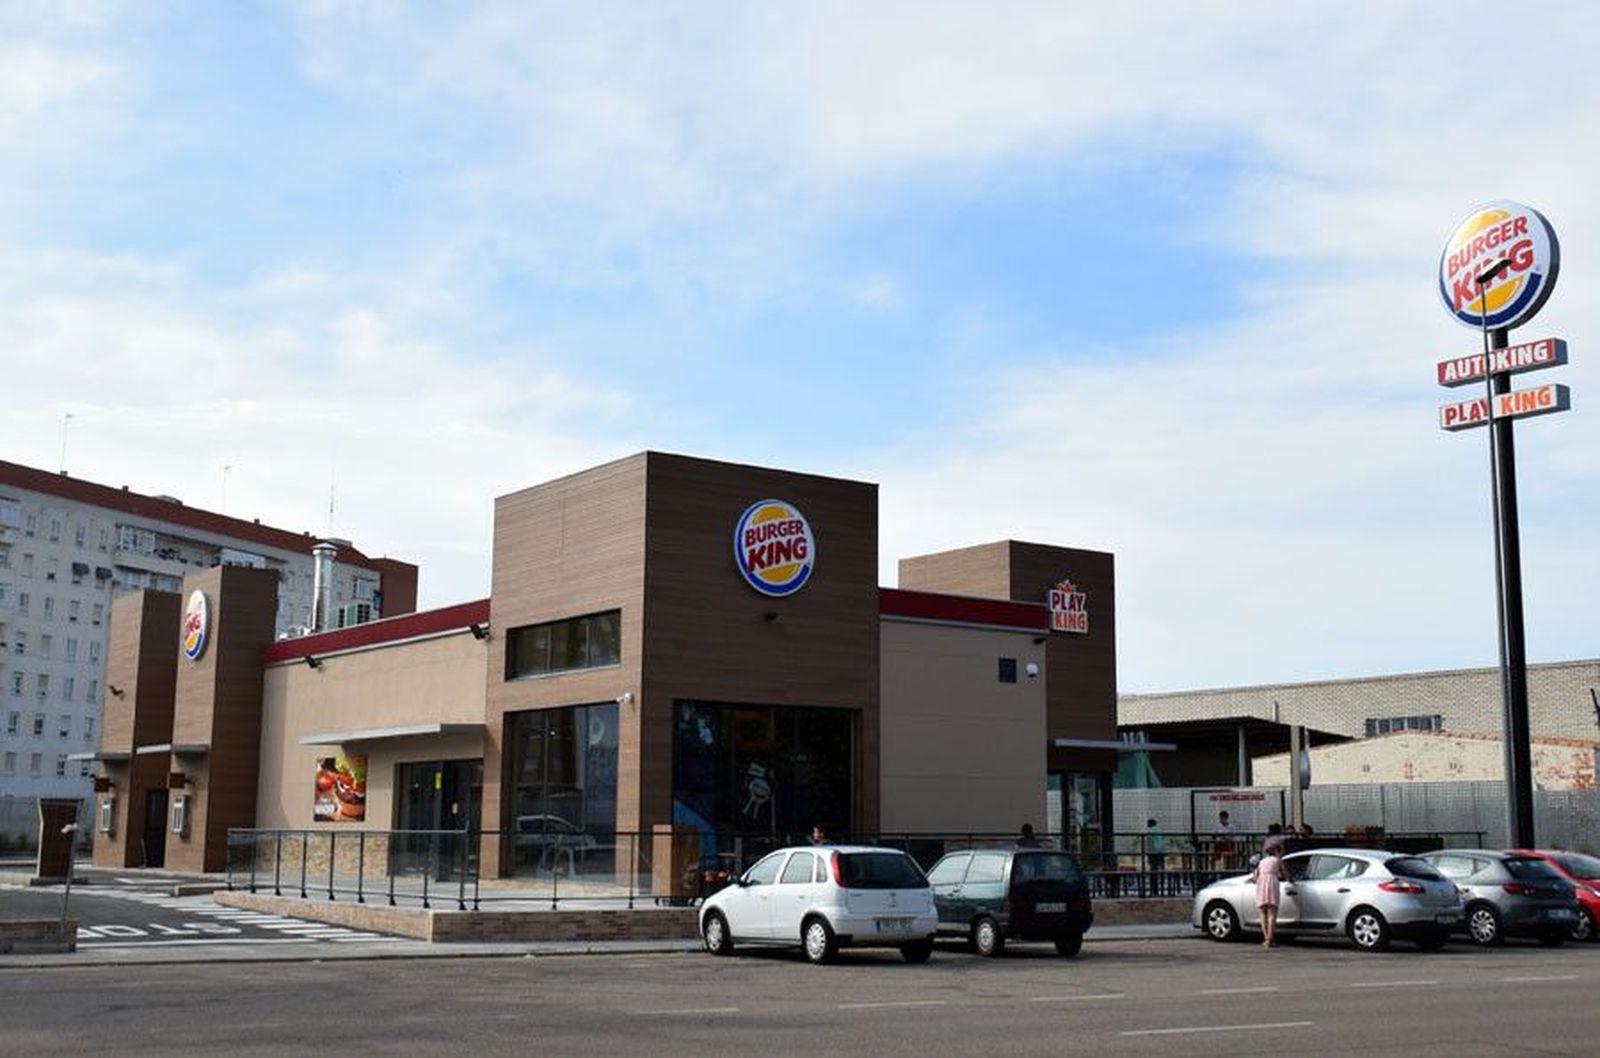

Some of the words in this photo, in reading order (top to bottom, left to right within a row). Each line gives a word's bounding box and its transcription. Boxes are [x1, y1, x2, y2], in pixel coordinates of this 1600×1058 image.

[1448, 215, 1528, 279] BURGER
[1445, 399, 1489, 425] PLAY
[1501, 387, 1551, 415] KING
[746, 520, 804, 547] BURGER
[748, 537, 807, 572] KING
[1052, 592, 1084, 612] PLAY
[1055, 612, 1085, 629] KING
